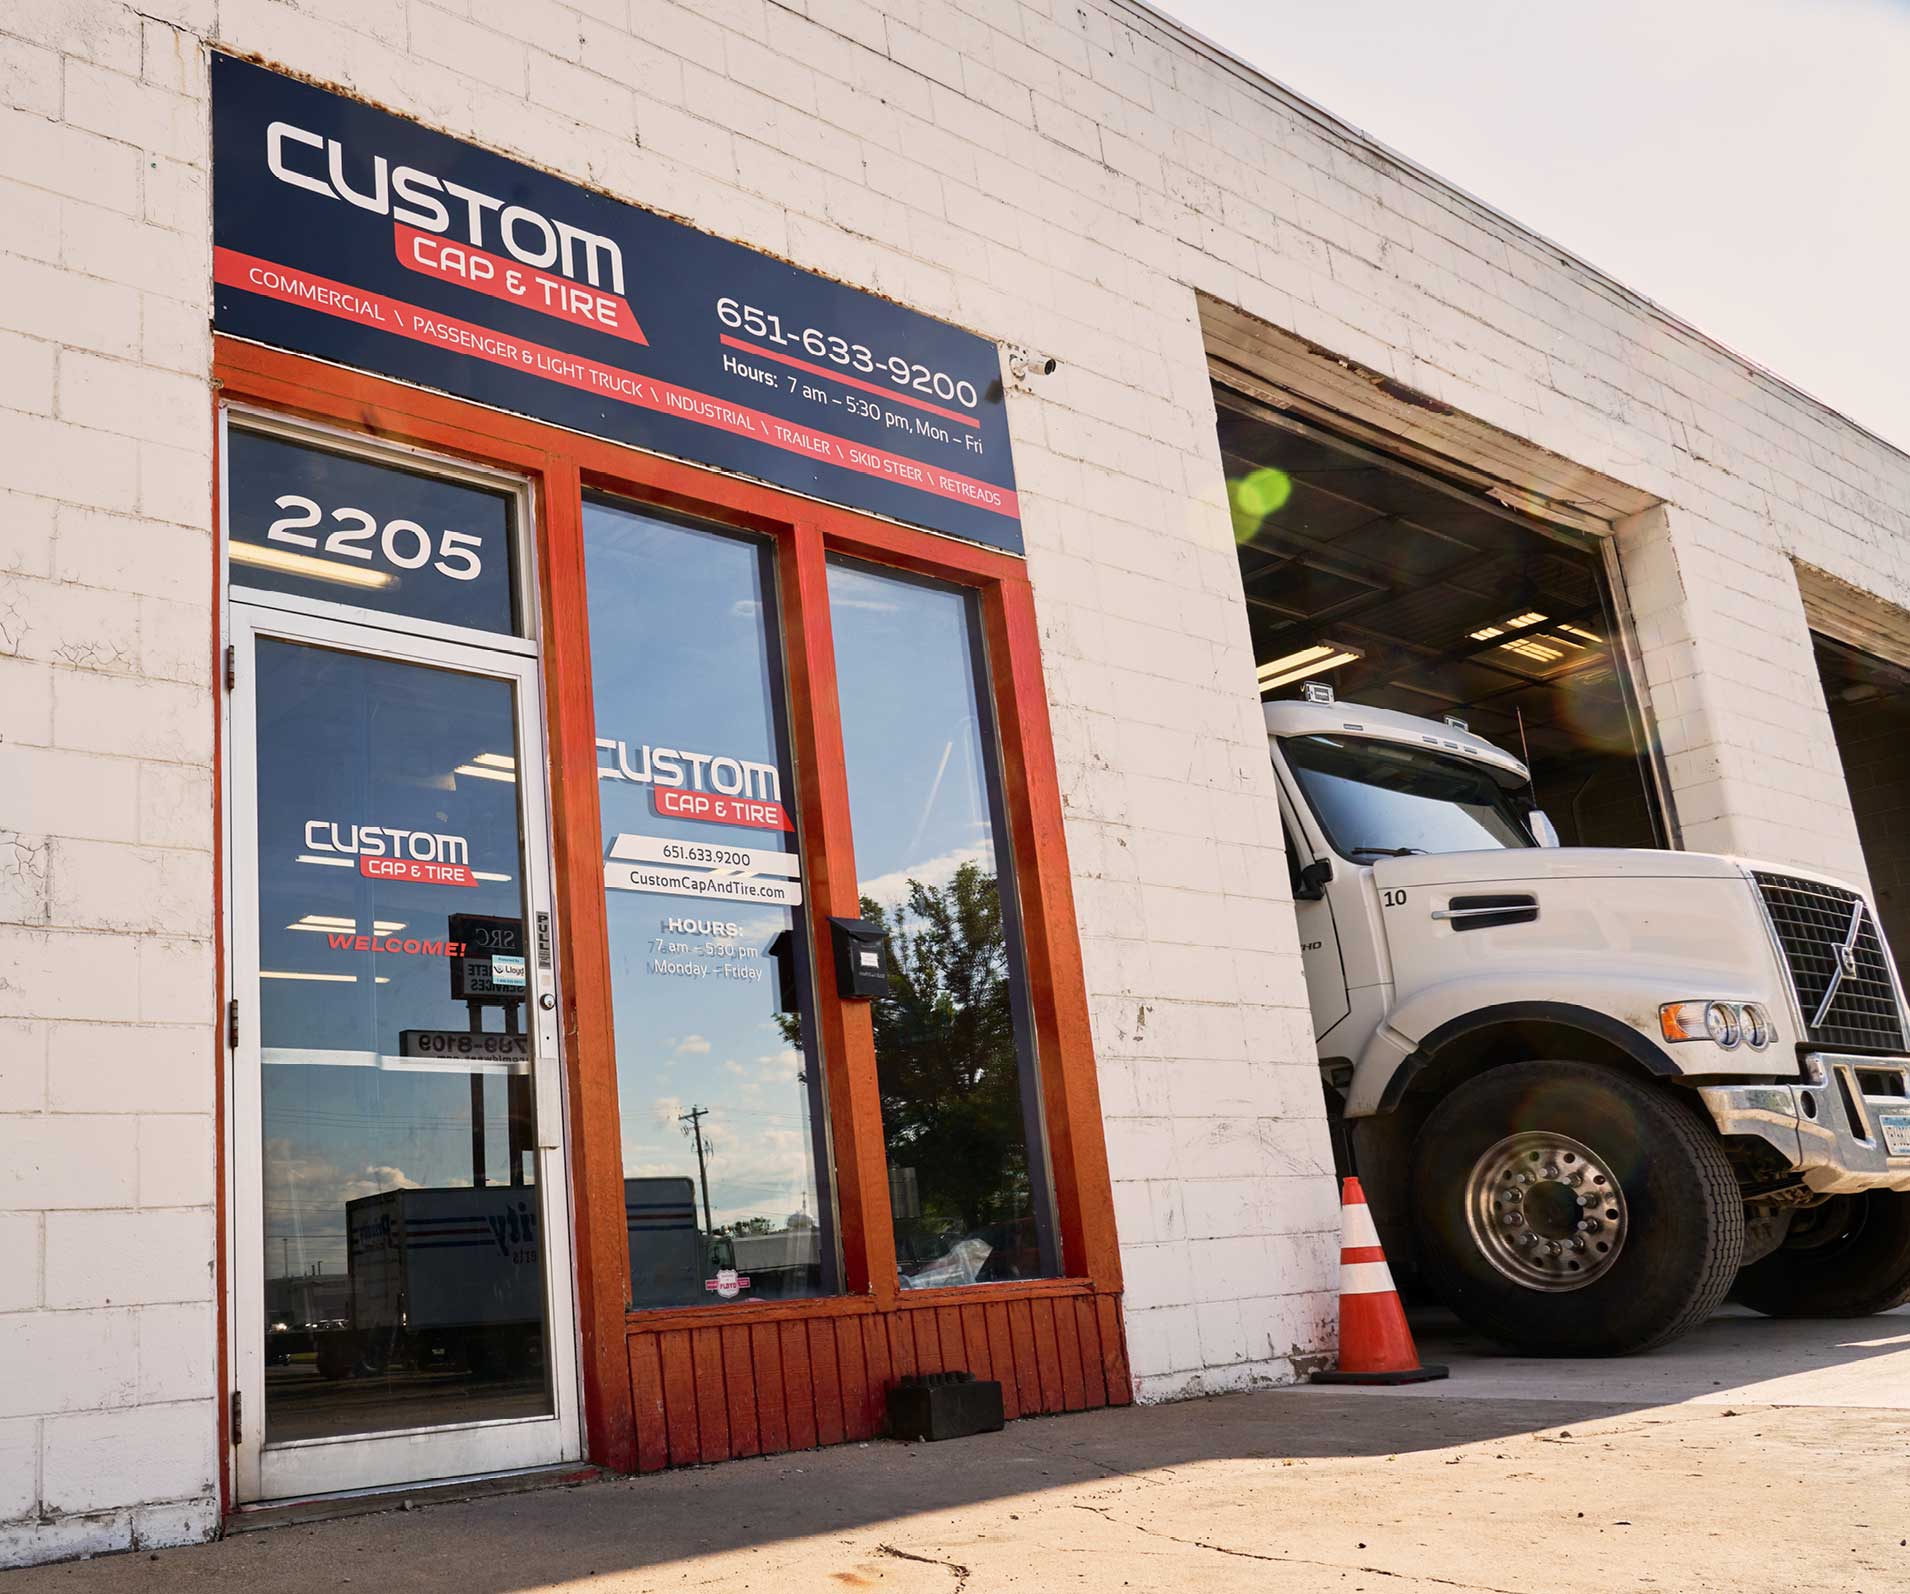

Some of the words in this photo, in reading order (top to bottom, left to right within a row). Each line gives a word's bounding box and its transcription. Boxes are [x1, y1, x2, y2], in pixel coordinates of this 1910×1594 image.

[267, 121, 625, 295] CUSTOM
[413, 236, 494, 281] CAP
[506, 270, 526, 296] &
[536, 277, 618, 327] TIRE
[717, 297, 977, 409] 651-633-9200
[249, 268, 385, 321] COMMERCIAL
[413, 316, 518, 361] PASSENGER
[522, 350, 533, 365] &
[537, 353, 585, 382] LIGHT
[589, 369, 643, 398] TRUCK
[666, 391, 755, 431] INDUSTRIAL
[775, 425, 831, 456] TRAILER
[849, 449, 881, 470] SKID
[884, 459, 923, 482] STEER
[940, 476, 1001, 506] RETREADS
[723, 354, 778, 388] Hours:
[787, 375, 797, 393] 7
[803, 386, 828, 405] am
[846, 397, 881, 421] 5:30
[886, 413, 913, 434] pm,
[916, 418, 949, 444] Mon
[966, 433, 983, 455] Fri
[267, 495, 482, 580] 2205
[596, 738, 781, 800] CUSTOM
[665, 793, 709, 813] CAP
[715, 802, 727, 817] &
[732, 802, 778, 824] TIRE
[305, 820, 468, 865] CUSTOM
[663, 845, 750, 867] 651.633.9200
[368, 860, 406, 876] CAP
[411, 865, 421, 877] &
[425, 865, 465, 881] TIRE
[630, 871, 785, 899] CustomCapAndTire.com
[1383, 889, 1407, 907] 10
[668, 917, 743, 937] HOURS:
[327, 934, 467, 957] WELCOME!
[655, 938, 664, 952] 7
[668, 942, 688, 953] am
[739, 946, 758, 959] pm
[1301, 941, 1322, 951] HD
[654, 959, 708, 977] Monday
[724, 963, 762, 980] Friday
